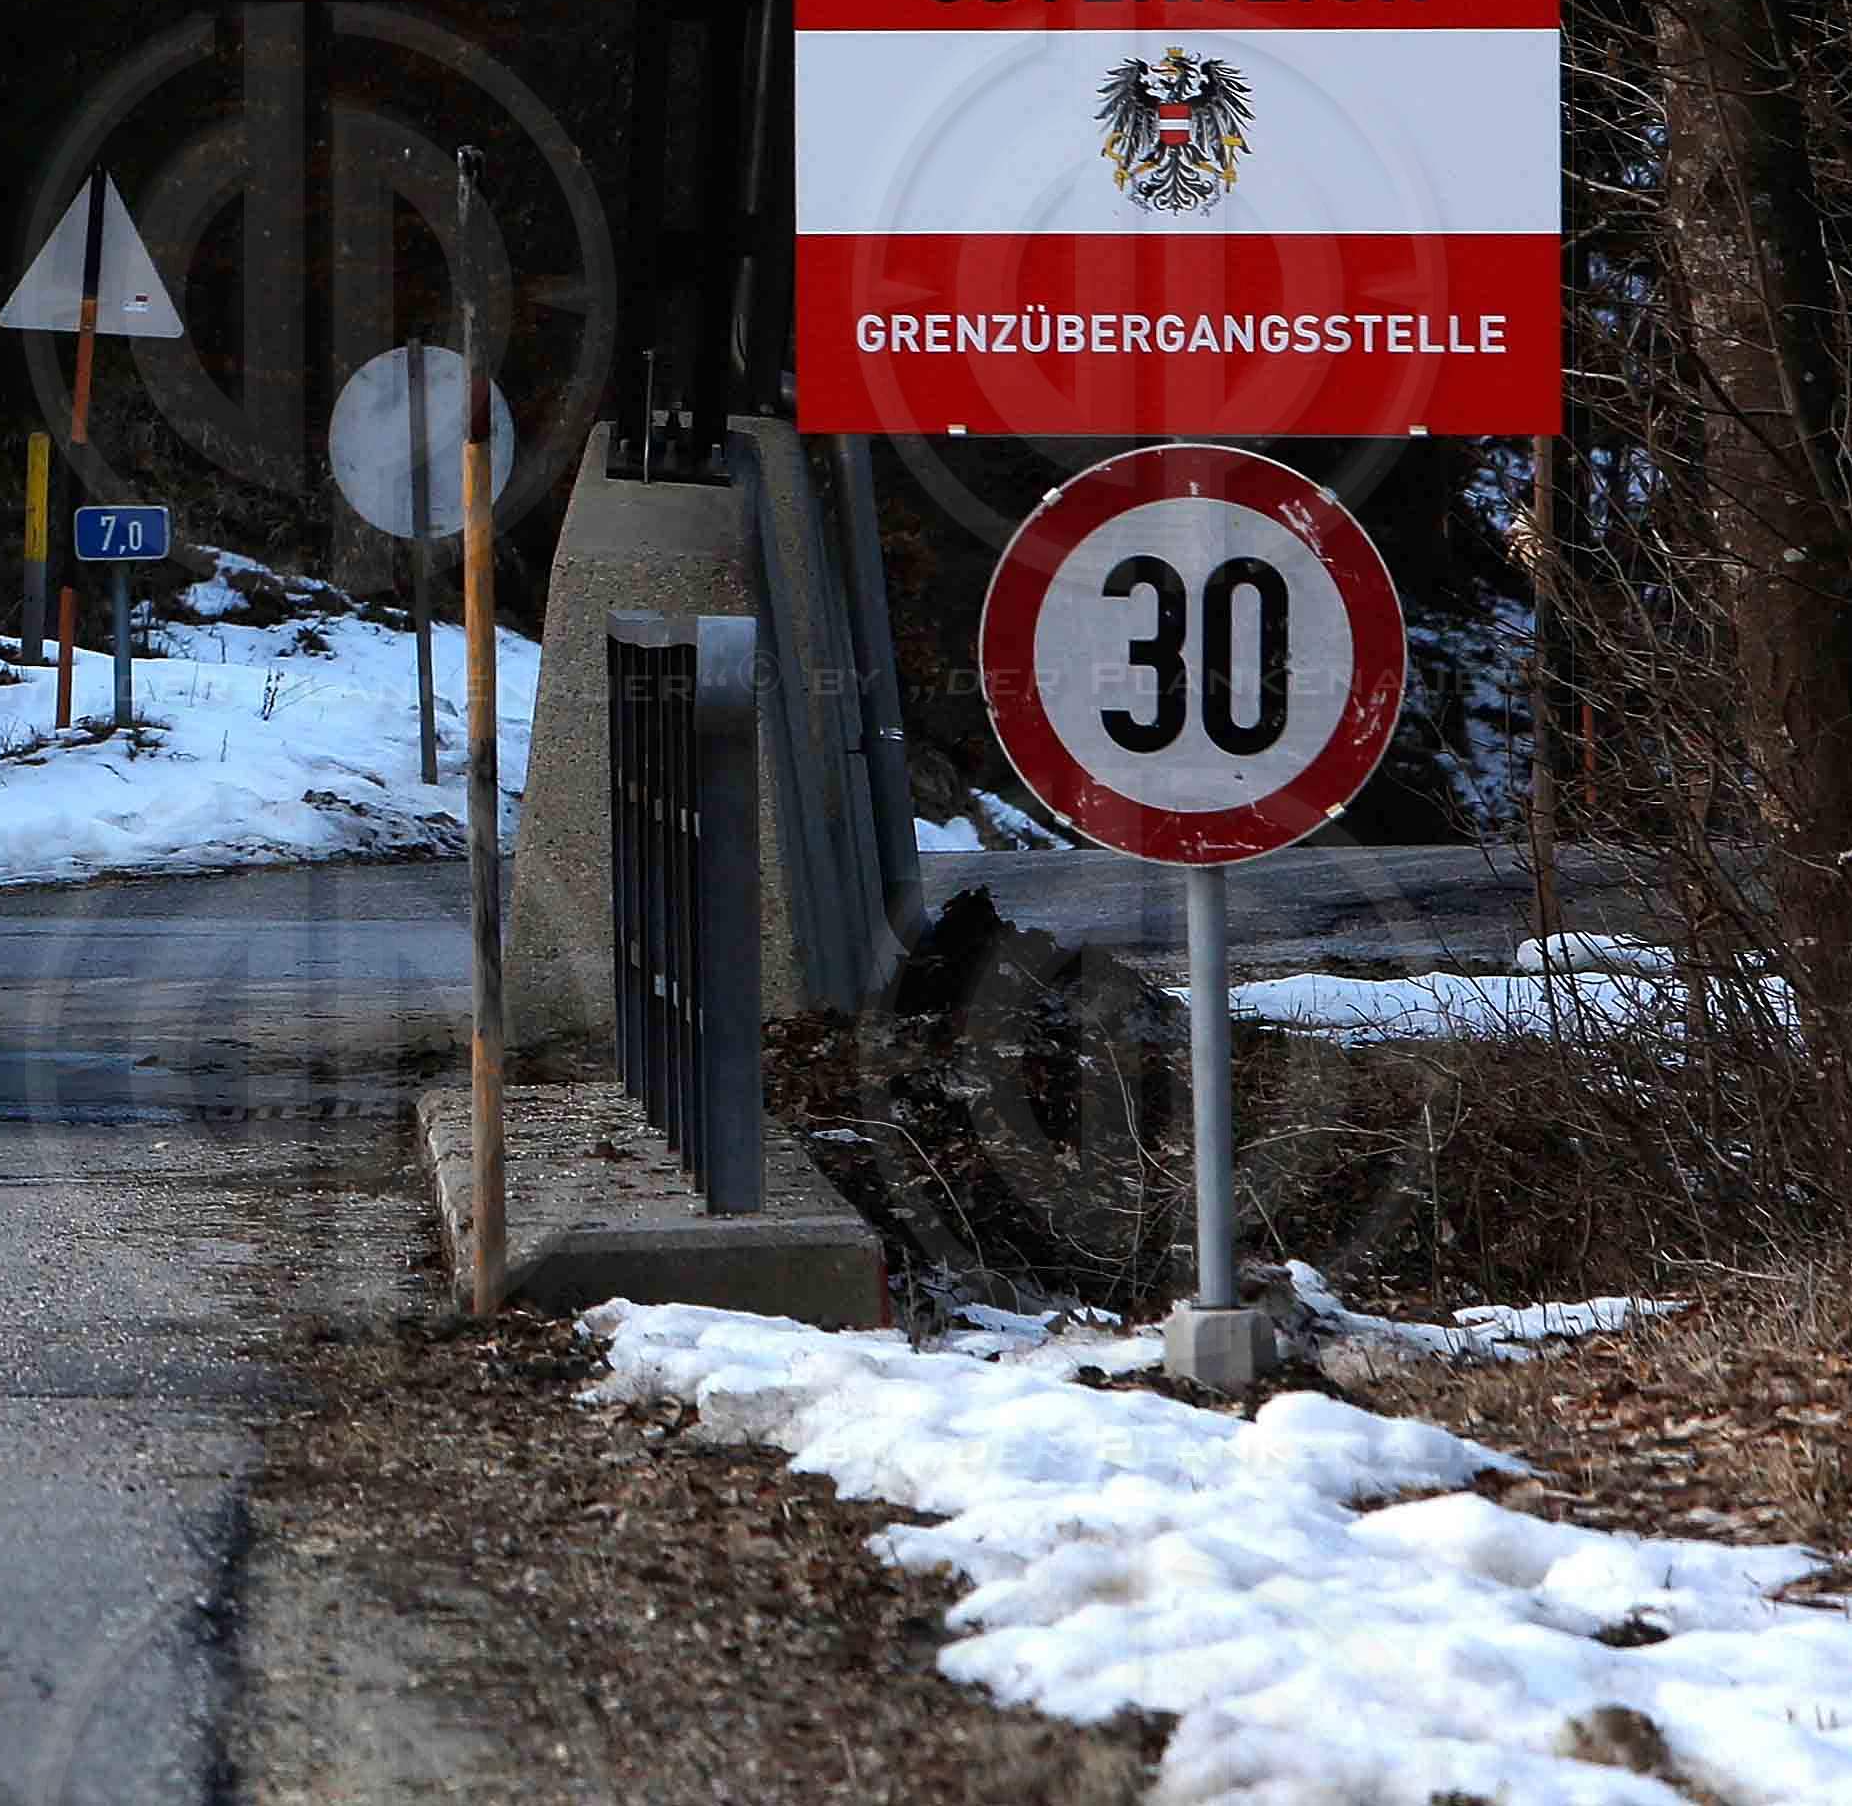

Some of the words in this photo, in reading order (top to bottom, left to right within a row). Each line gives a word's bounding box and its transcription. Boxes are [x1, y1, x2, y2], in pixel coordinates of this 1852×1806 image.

[856, 303, 1507, 354] GRENZÜBERGANGSSTELLE
[100, 514, 142, 555] 7,0
[1100, 555, 1290, 756] 30
